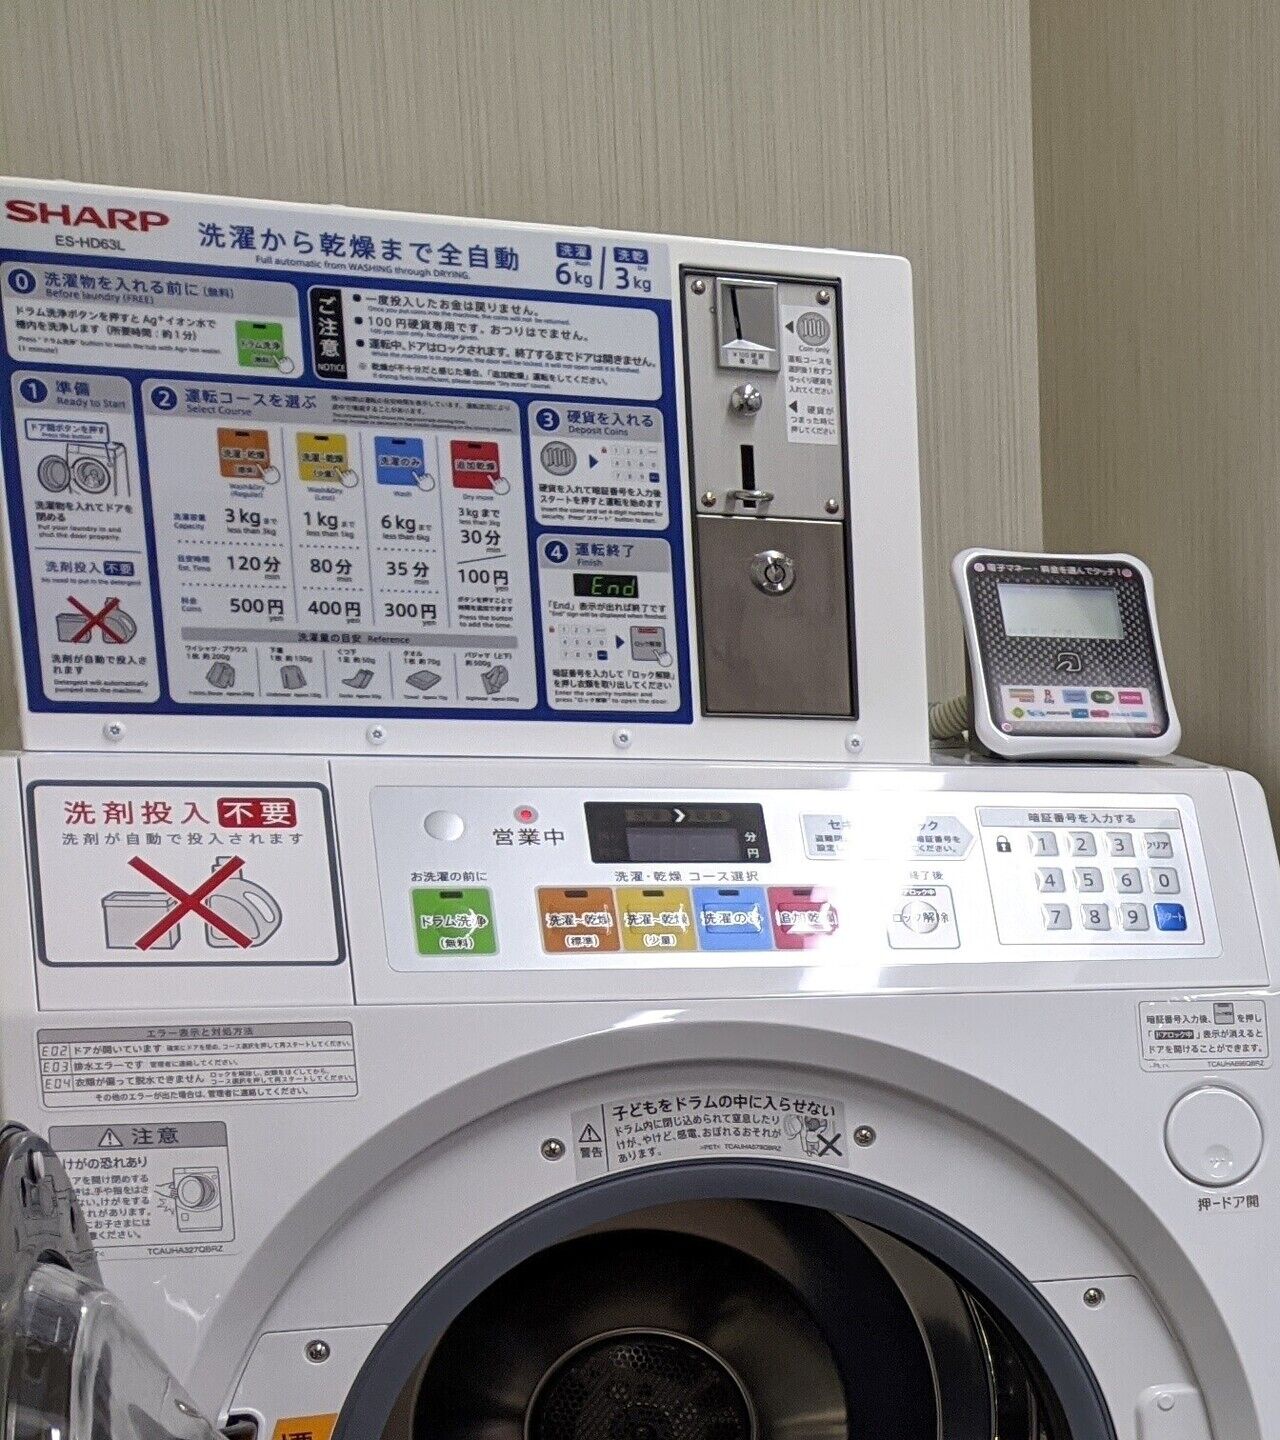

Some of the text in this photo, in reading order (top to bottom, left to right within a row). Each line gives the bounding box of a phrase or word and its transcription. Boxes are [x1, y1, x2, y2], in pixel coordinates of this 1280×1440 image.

[5, 200, 170, 231] SHARP
[55, 235, 125, 251] ES-HD63L
[198, 222, 519, 271] 洗濯から乾燥まで全自動
[256, 255, 272, 265] Full
[274, 257, 319, 268] automatic
[324, 262, 345, 270] from
[348, 263, 391, 274] WASHING
[394, 266, 431, 278] through
[44, 272, 198, 295] 洗濯物を入れる前に
[46, 289, 79, 299] Before
[319, 295, 340, 359] ご注意
[317, 363, 346, 373] NOTICE
[56, 381, 90, 397] 準備
[58, 397, 125, 409] Ready Start
[186, 388, 316, 409] 運転コースを選ぶ
[187, 404, 251, 416] Select Course
[567, 411, 654, 428] 硬貨を入れる
[569, 426, 629, 437] Deposit Coins
[35, 500, 133, 514] 洗濯物を入れてドアを
[576, 543, 635, 558] 運転終了
[46, 561, 133, 576] 洗剤投入 不要
[578, 558, 602, 567] Finish
[592, 577, 636, 597] End
[367, 635, 410, 645] Reference
[64, 801, 292, 825] 洗剤投入 不要
[1028, 812, 1136, 825] 暗証番号を入力する
[62, 832, 304, 846] 洗剤が自動で投入されます
[493, 828, 567, 847] 営業中
[747, 847, 760, 860] 円
[410, 871, 488, 882] お洗濯の前に
[689, 870, 760, 882] コース選択
[1044, 873, 1132, 887] 4 5 6
[1050, 910, 1139, 925] 7 8 9
[147, 1027, 254, 1038] エラー表示と対処方法
[73, 1043, 162, 1055] ドアが開いています
[1148, 1043, 1263, 1055] ドアを開けることができます。
[73, 1059, 144, 1072] 排水エラーです
[75, 1073, 206, 1089] 衣類が偏って脱水できません
[612, 1094, 835, 1121] 子どもをドラムの中に入らせない
[615, 1113, 781, 1135] ドラム内に閉じ込められて窒息したり
[131, 1127, 179, 1145] 注意
[579, 1146, 602, 1159] 警告
[617, 1150, 662, 1164] あります。
[63, 1157, 148, 1171] けがの恐れあり
